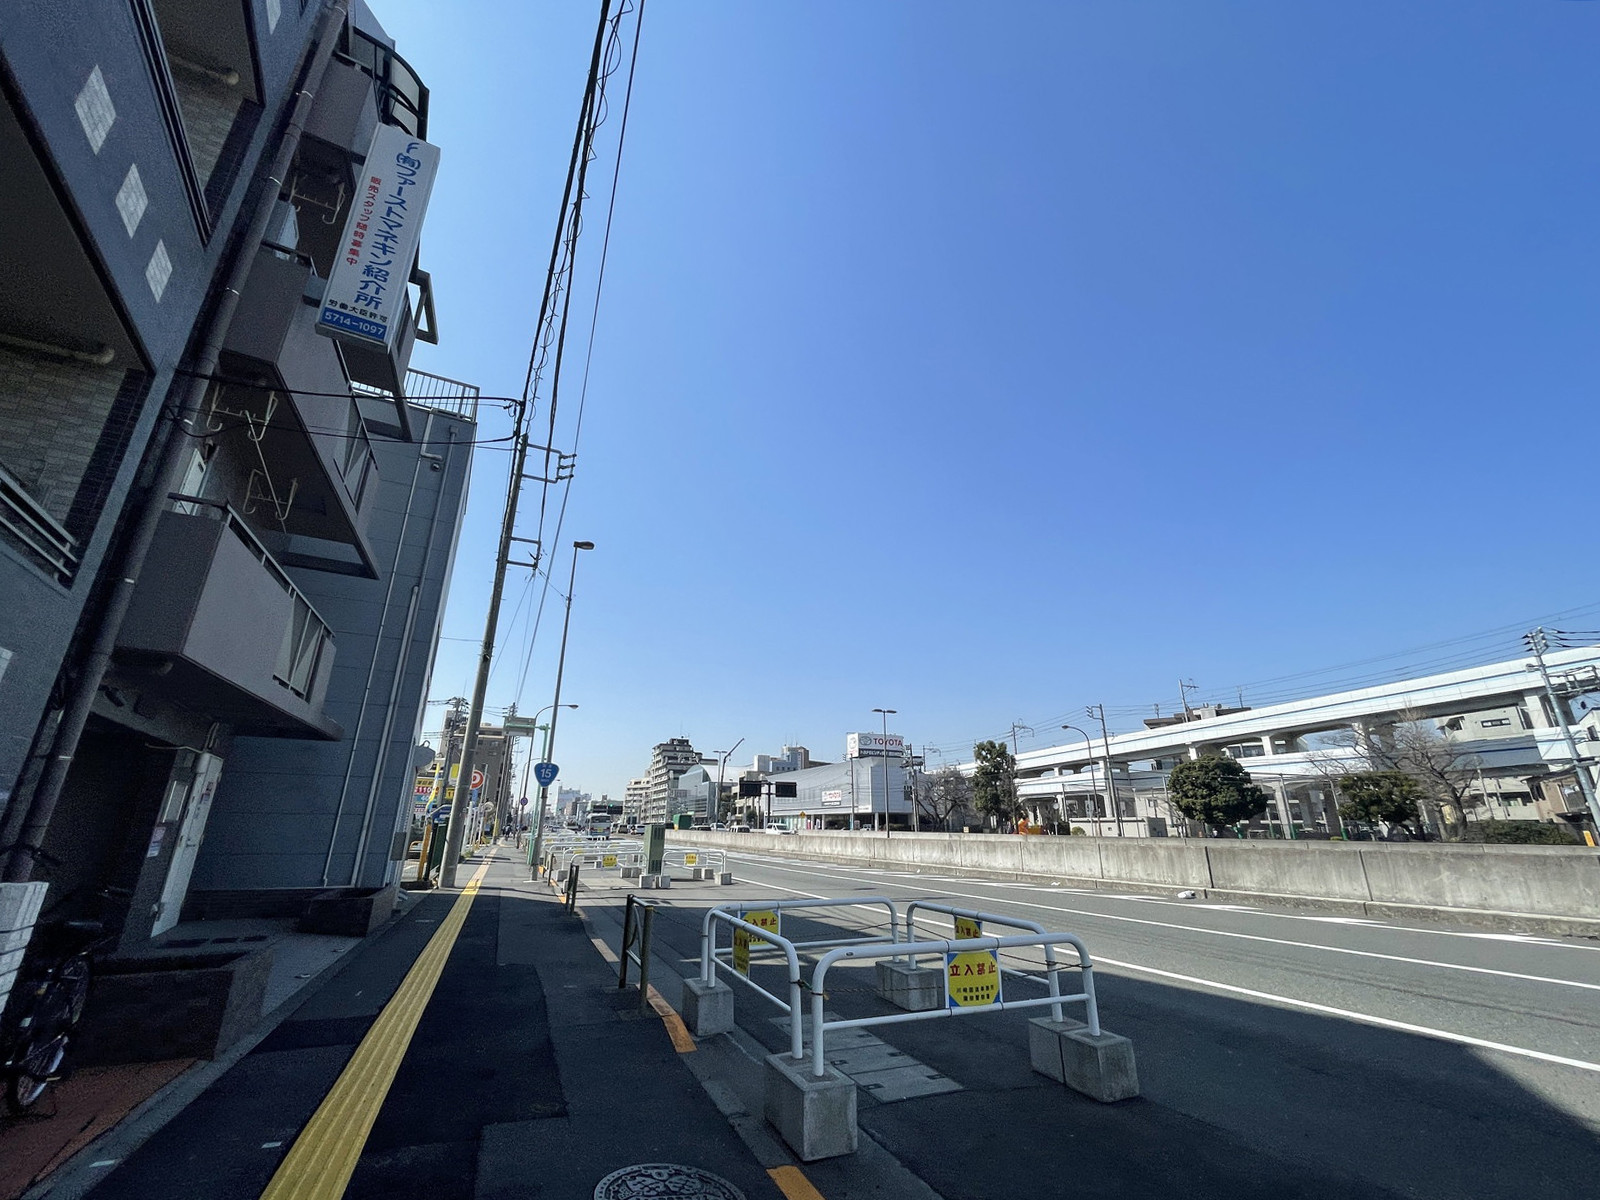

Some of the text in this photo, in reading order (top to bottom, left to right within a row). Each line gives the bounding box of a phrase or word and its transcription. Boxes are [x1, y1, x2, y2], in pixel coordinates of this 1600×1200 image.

[324, 311, 385, 336] 5714-1097
[873, 738, 903, 746] TOYOTA
[540, 768, 552, 778] 15
[744, 917, 777, 927] 入禁止
[950, 961, 996, 976] 立入禁止
